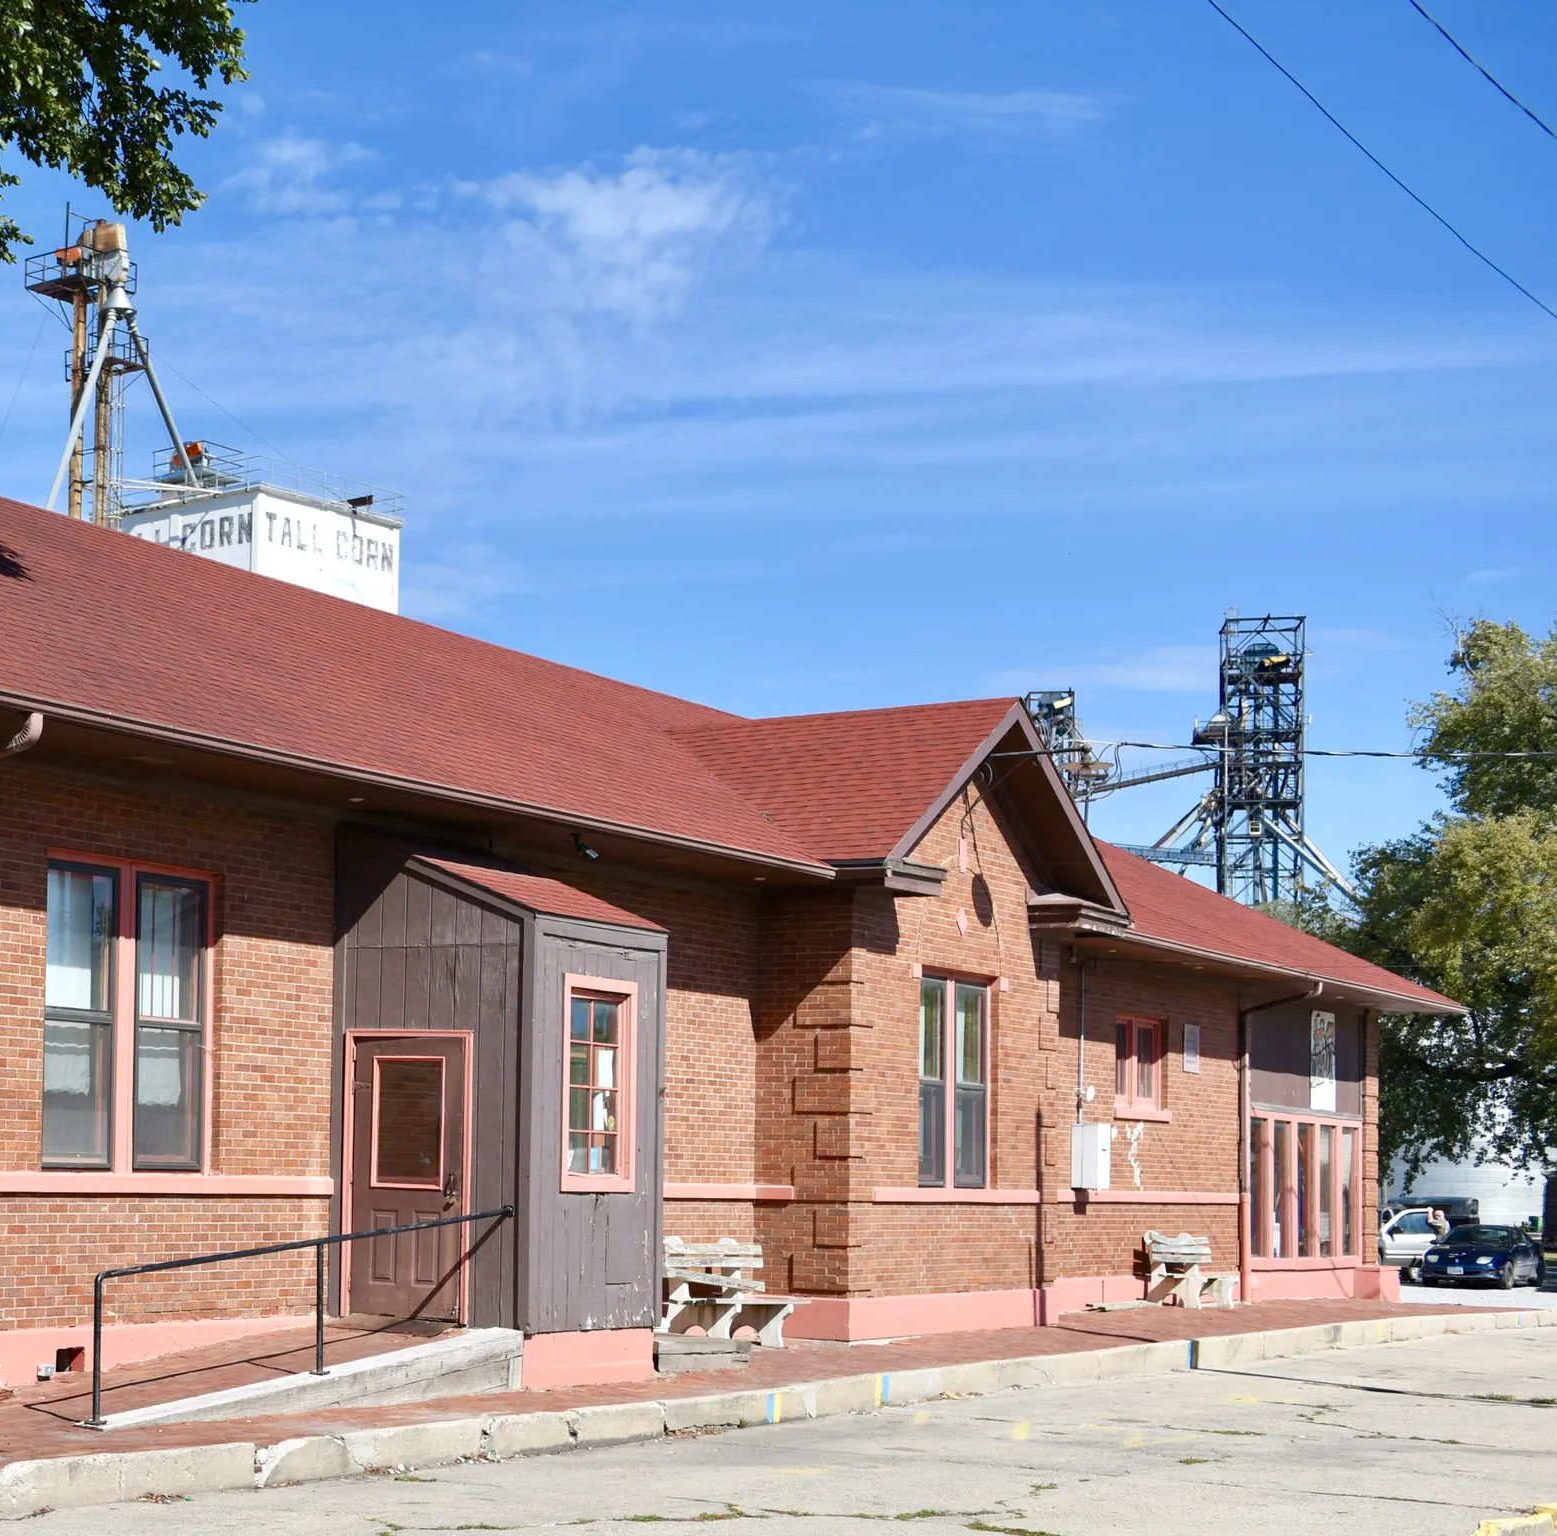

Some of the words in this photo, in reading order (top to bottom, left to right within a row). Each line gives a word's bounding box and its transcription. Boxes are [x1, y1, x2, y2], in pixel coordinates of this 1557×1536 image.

[182, 511, 253, 553] CORN
[265, 511, 323, 554] TALL
[336, 529, 394, 574] CORN
